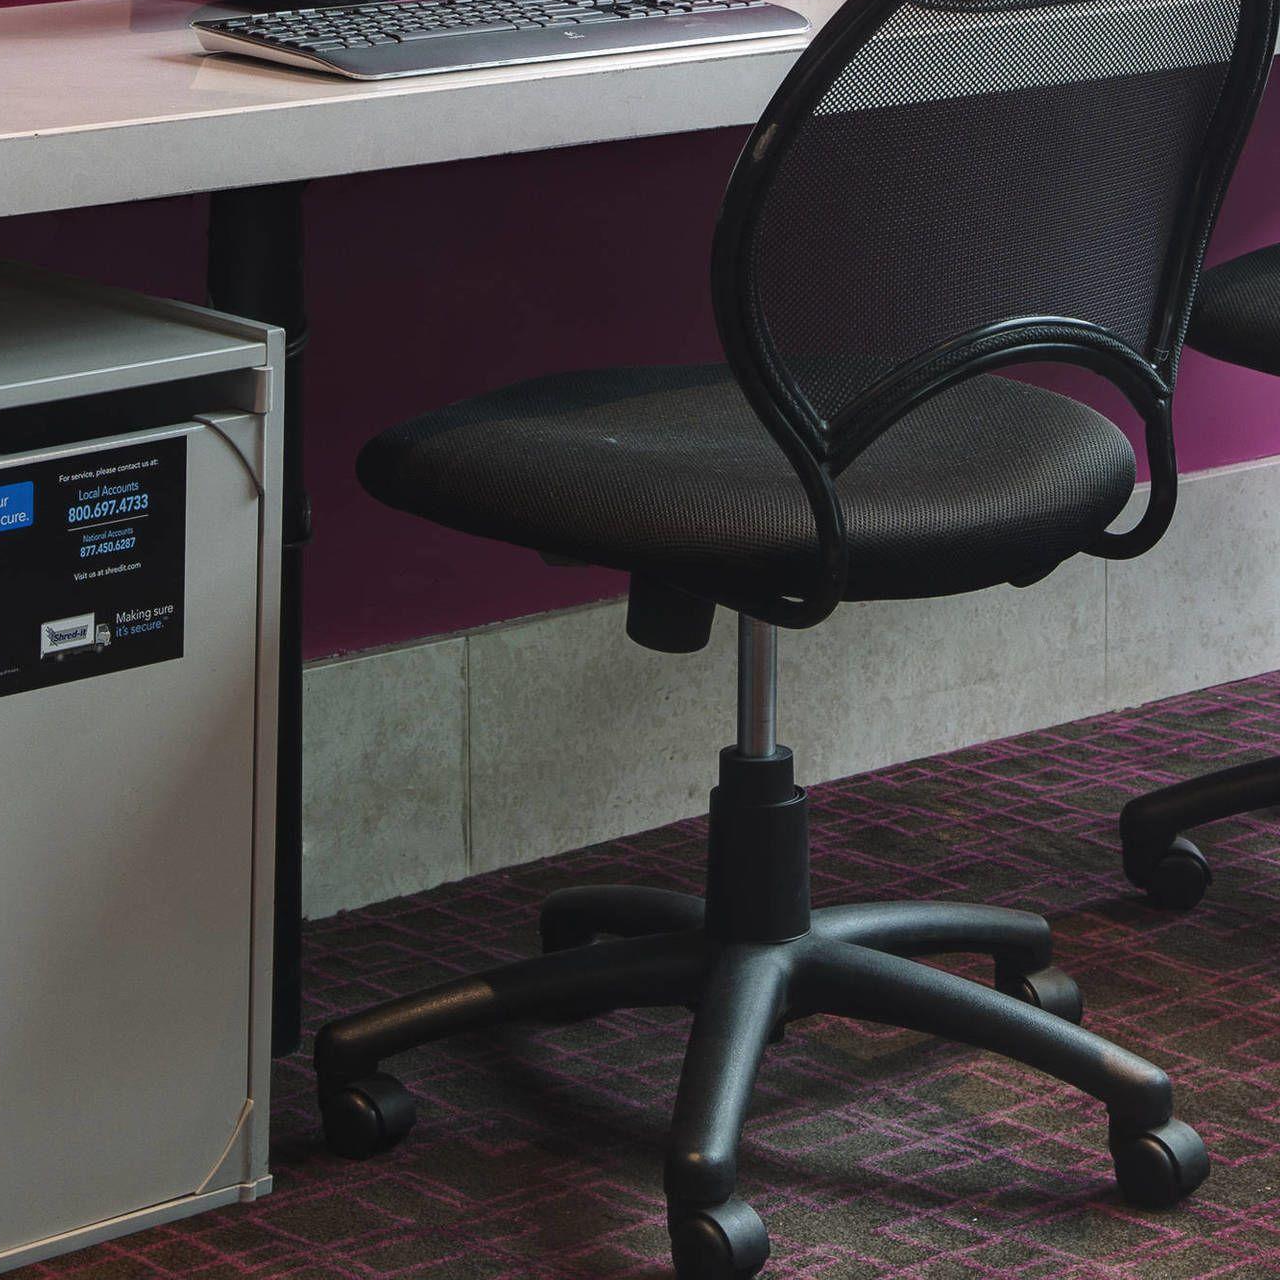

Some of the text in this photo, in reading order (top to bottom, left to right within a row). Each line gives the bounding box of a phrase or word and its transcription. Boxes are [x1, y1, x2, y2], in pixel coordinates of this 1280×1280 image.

[59, 474, 70, 483] For
[71, 471, 95, 481] service,
[96, 466, 117, 477] please
[117, 461, 141, 472] contact
[141, 460, 149, 468] us
[79, 481, 139, 501] Local Accounts
[68, 494, 149, 523] 800.697.4733
[82, 527, 134, 543] National Accounts
[80, 537, 136, 558] 877.450.6287
[73, 571, 88, 581] Visit
[96, 569, 104, 577] at
[105, 561, 142, 576] shredit.com
[116, 604, 174, 624] Making sure
[53, 627, 87, 642] Shred-it
[115, 626, 129, 638] it's
